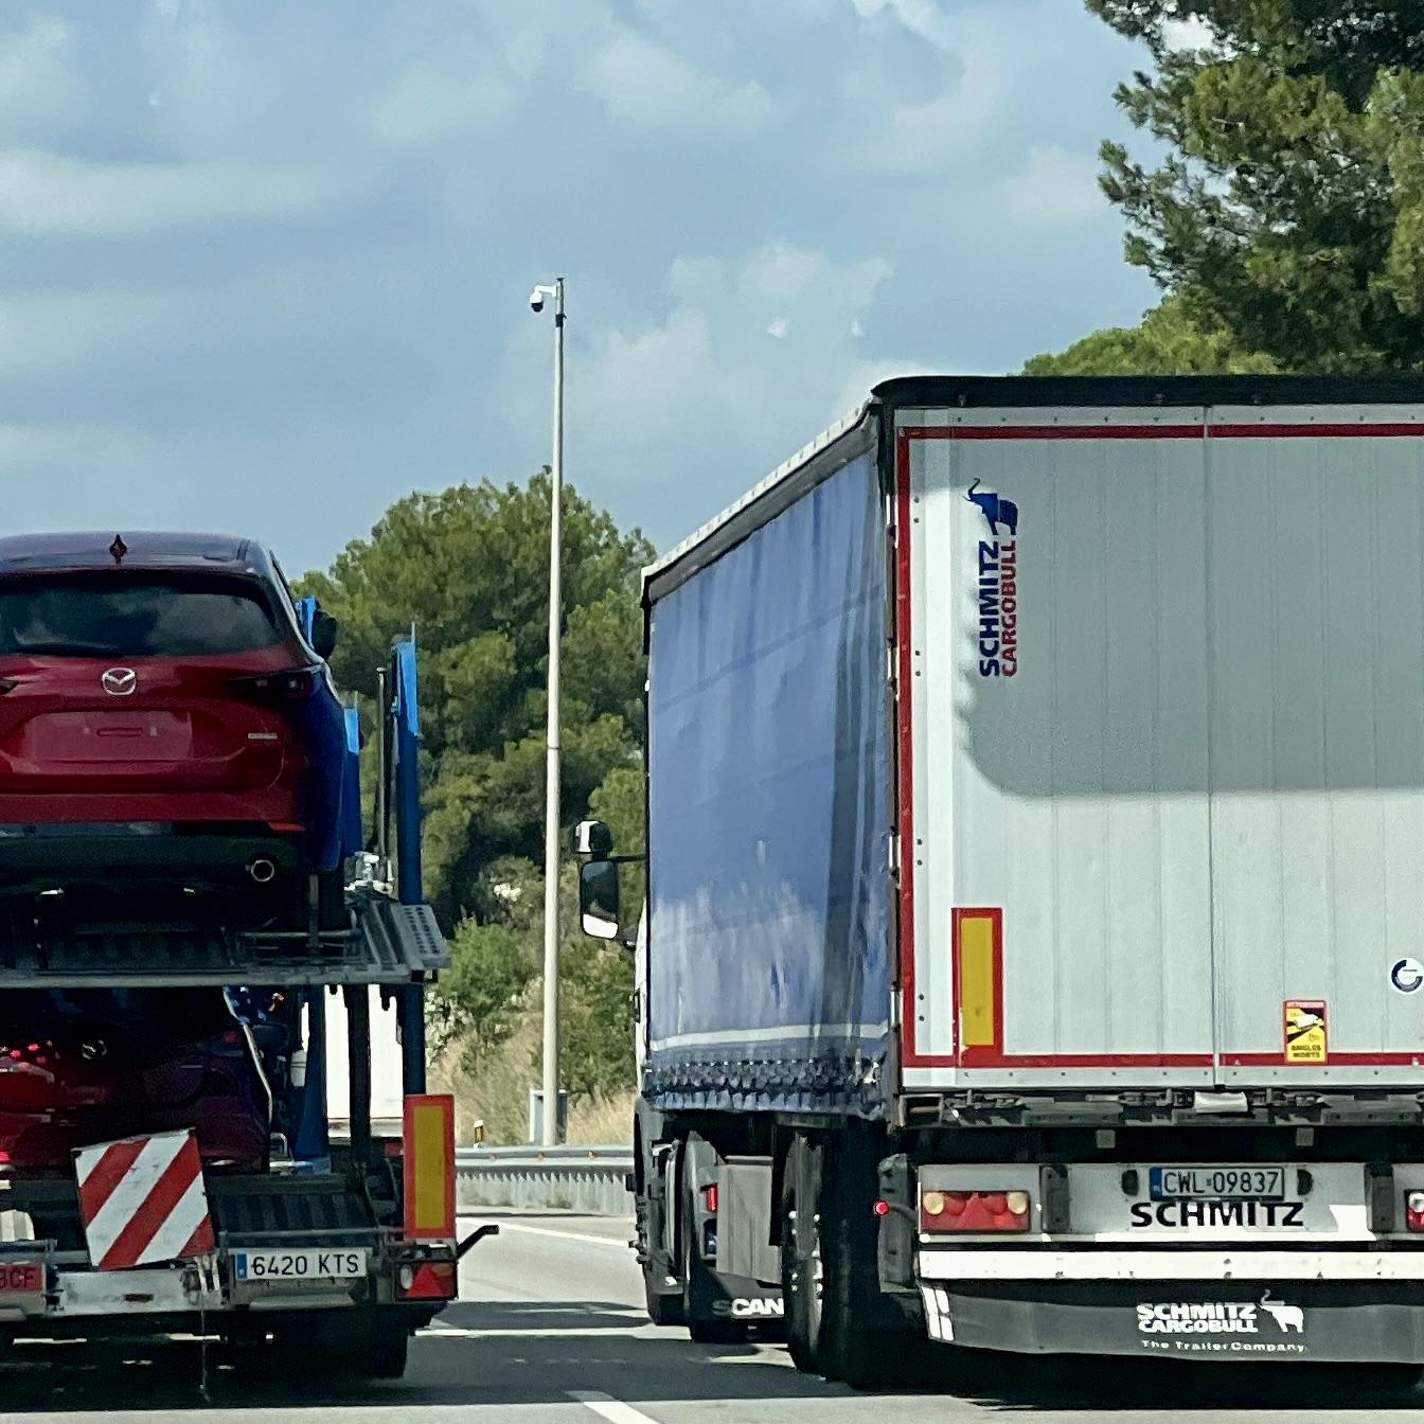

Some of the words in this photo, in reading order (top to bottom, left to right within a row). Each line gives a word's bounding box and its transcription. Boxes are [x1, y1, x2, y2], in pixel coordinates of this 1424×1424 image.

[978, 540, 1000, 678] SCHMITZ
[1000, 540, 1018, 678] CARGOBULL
[1164, 1171, 1205, 1194] CWL
[1212, 1171, 1280, 1194] 09837
[1130, 1202, 1305, 1228] SCHMITZ
[251, 1255, 308, 1276] 6420
[318, 1253, 360, 1274] KTS
[1136, 1302, 1258, 1320] SCHMITZ
[1138, 1319, 1259, 1333] CARGOBULL
[1141, 1339, 1170, 1350] The
